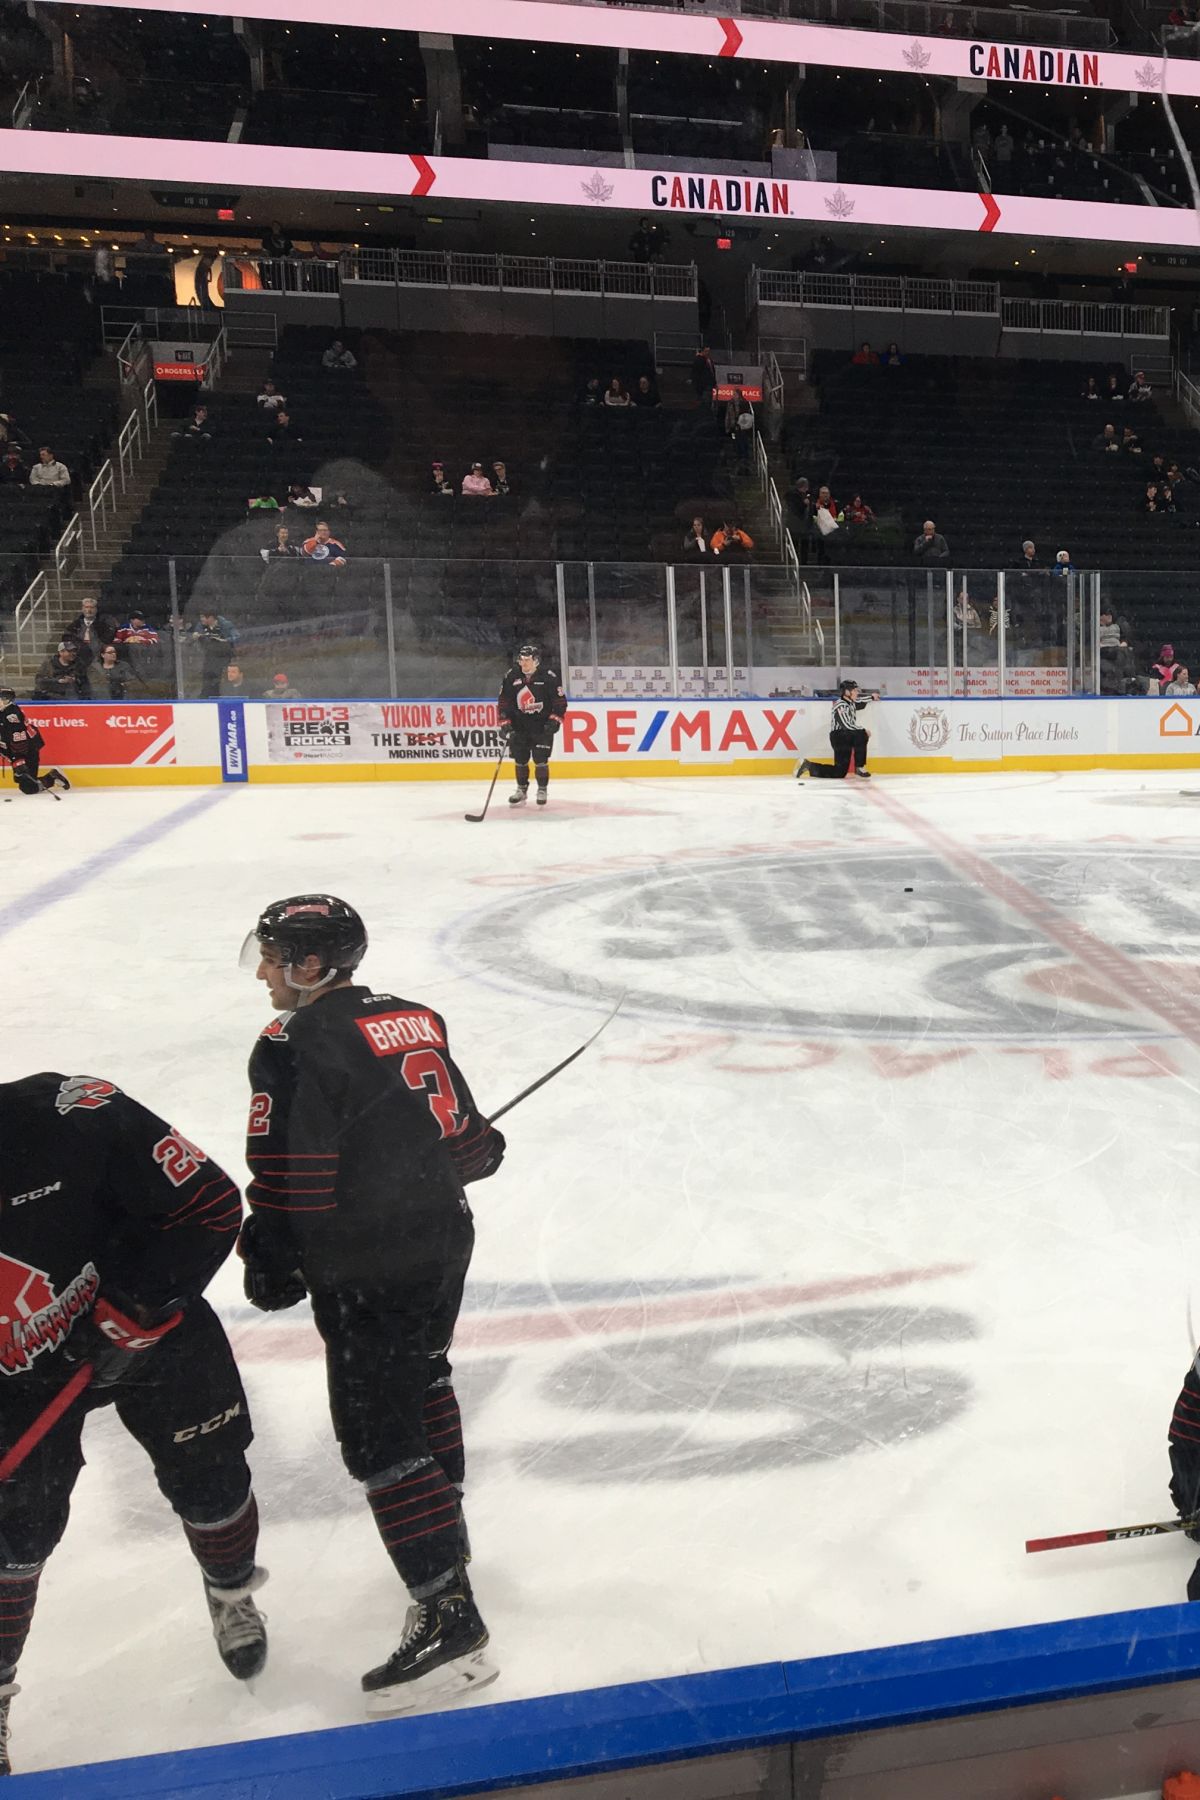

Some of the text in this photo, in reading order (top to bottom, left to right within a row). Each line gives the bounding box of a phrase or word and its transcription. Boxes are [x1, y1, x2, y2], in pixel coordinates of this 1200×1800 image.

[969, 44, 1099, 86] CANADIAN
[651, 175, 789, 215] CANADIAN
[53, 717, 88, 728] Lives.
[116, 715, 158, 728] CLAC
[381, 704, 432, 728] YUKON
[435, 708, 447, 725] &
[290, 736, 345, 746] ROCKS
[371, 733, 400, 747] THE
[406, 732, 448, 747] BEST
[563, 710, 799, 753] RE/MAX
[957, 721, 1079, 742] The Sutton Place Hotels
[388, 749, 440, 759] MORNING
[442, 748, 474, 758] SHOW
[361, 994, 392, 1004] CCM
[247, 1093, 273, 1136] 2
[11, 1181, 62, 1206] CCM
[100, 1319, 160, 1349] CC
[172, 1402, 241, 1443] CCM
[1114, 1526, 1158, 1540] CCM
